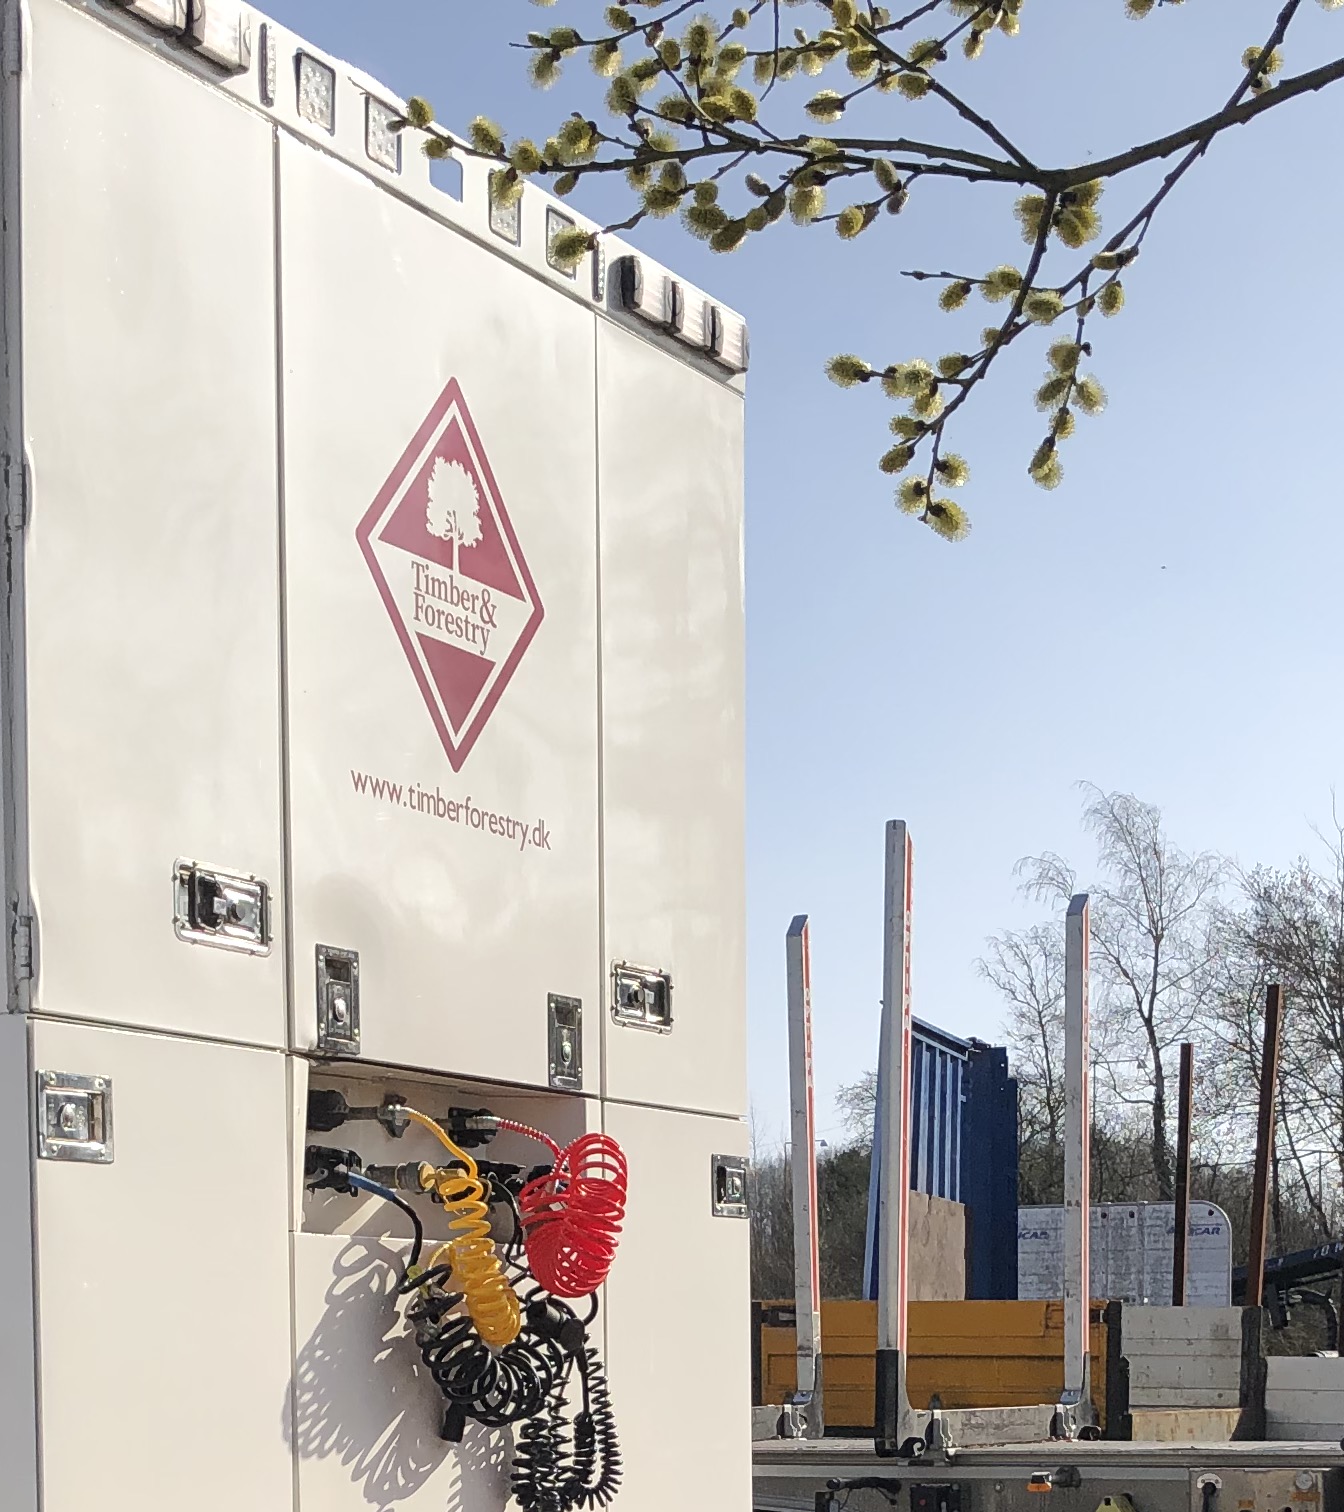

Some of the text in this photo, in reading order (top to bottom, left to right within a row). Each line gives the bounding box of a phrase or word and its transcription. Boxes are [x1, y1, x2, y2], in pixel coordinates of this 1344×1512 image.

[411, 560, 497, 628] Timber&
[413, 591, 490, 656] Forestry
[350, 769, 551, 851] www.timberforestry.dk
